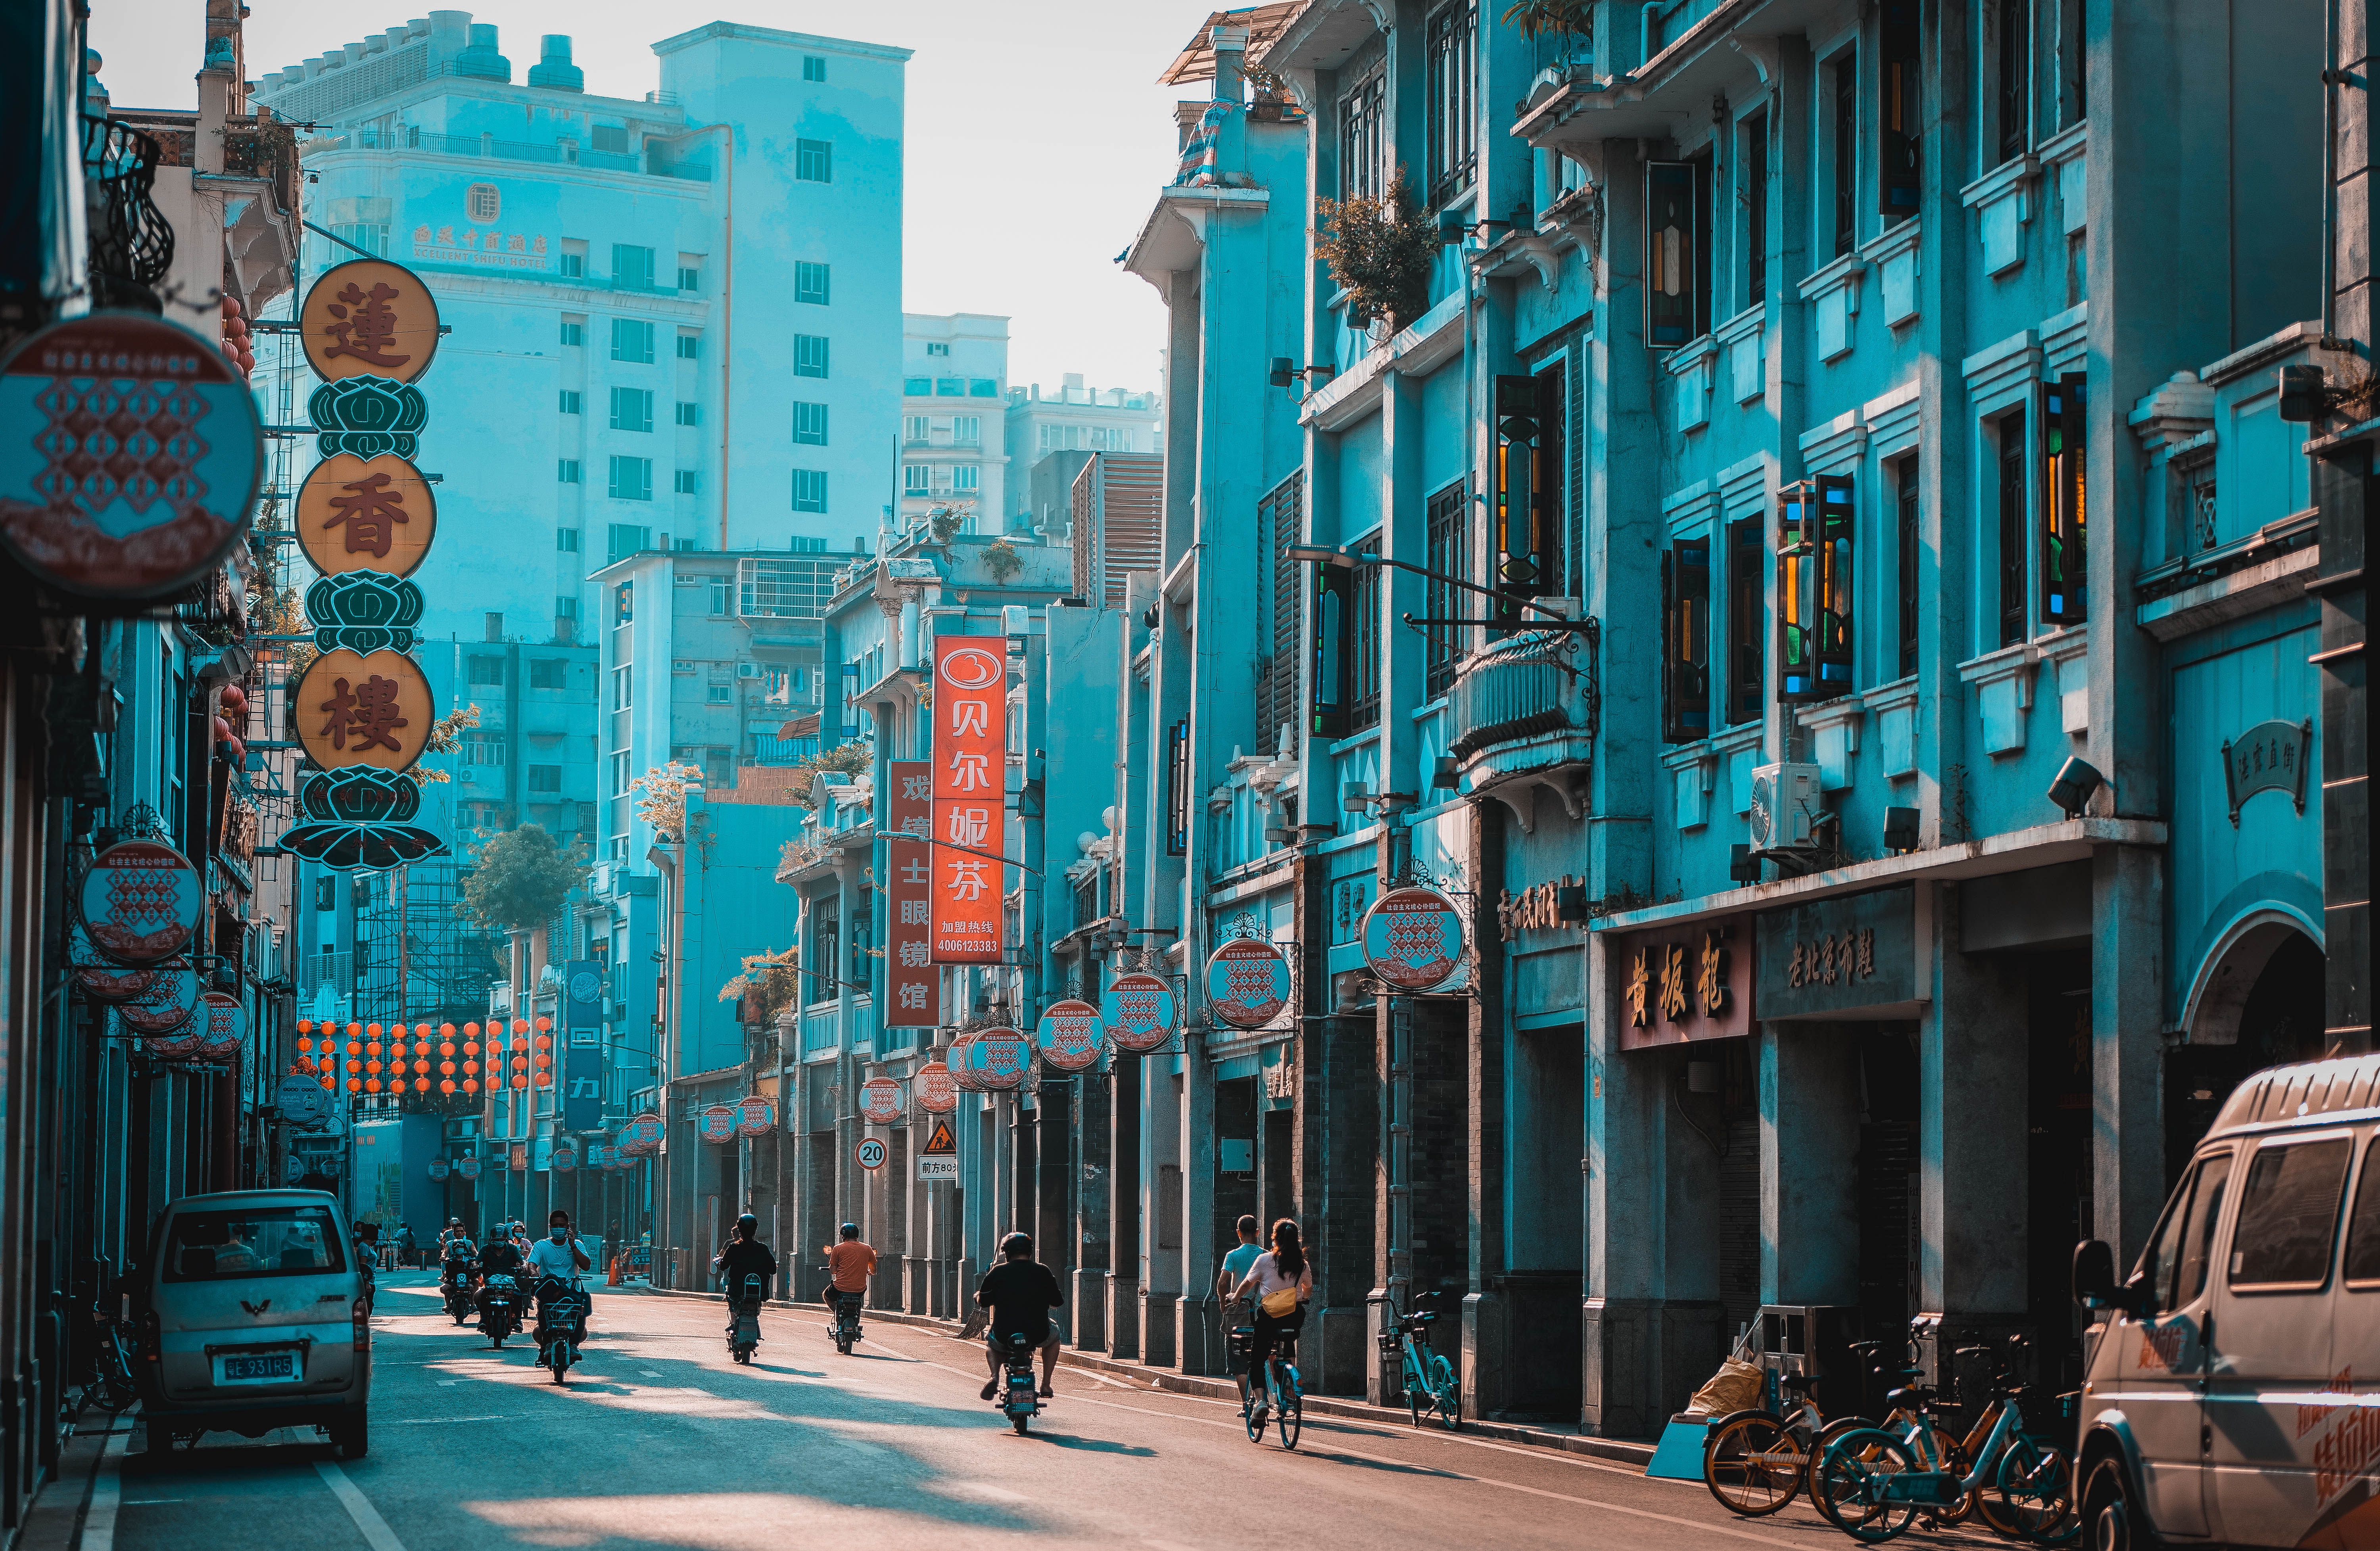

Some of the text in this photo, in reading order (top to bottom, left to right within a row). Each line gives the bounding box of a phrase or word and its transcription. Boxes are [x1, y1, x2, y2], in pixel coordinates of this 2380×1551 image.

[474, 254, 505, 265] SHIFU
[511, 258, 546, 269] HOTEL
[947, 700, 991, 901] 贝尔妮芬
[1387, 902, 1440, 911] 社会主义核心价值观
[941, 920, 994, 934] 加盟热线
[938, 939, 997, 952] 4006123383
[570, 1027, 599, 1099] 回力
[862, 1146, 883, 1161] 20
